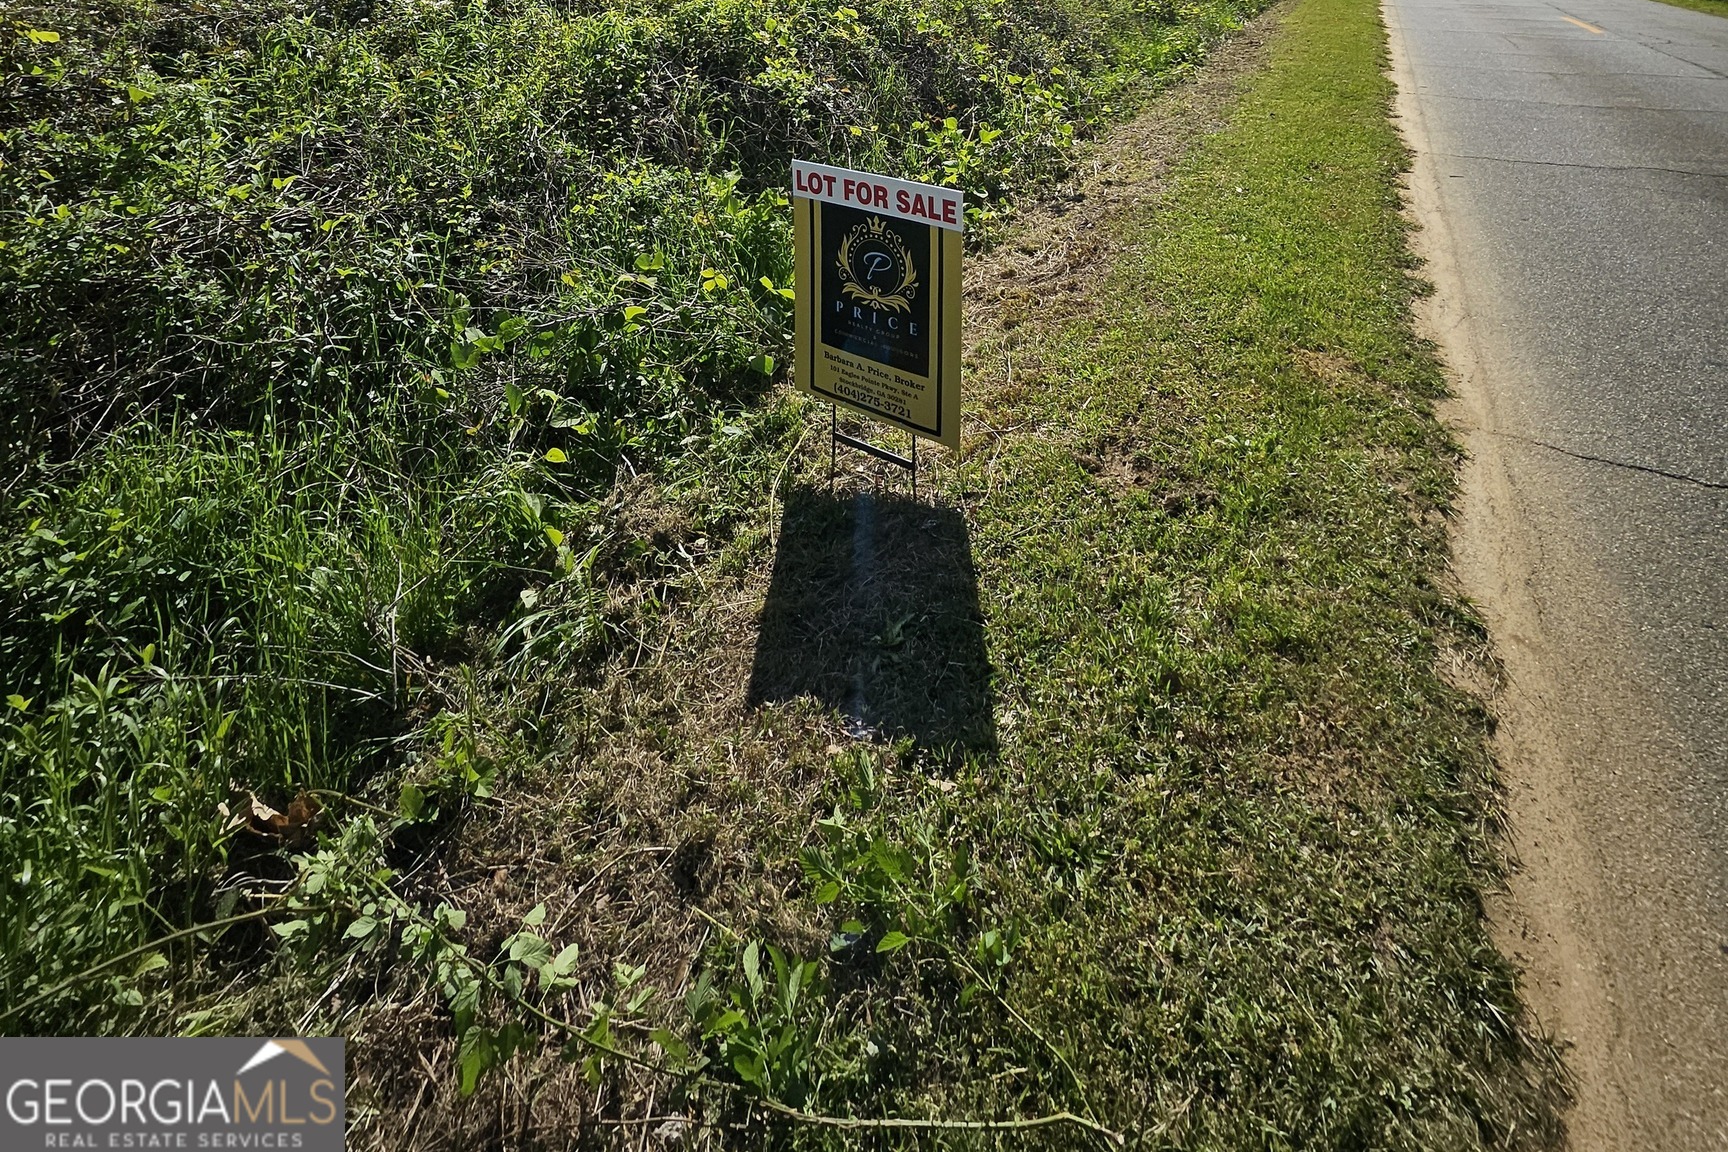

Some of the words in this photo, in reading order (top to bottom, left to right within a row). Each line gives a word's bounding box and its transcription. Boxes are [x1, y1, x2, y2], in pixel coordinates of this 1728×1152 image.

[796, 169, 837, 198] LOT
[843, 178, 889, 210] FOR
[896, 189, 957, 225] SALE
[836, 300, 918, 336] PRICE
[824, 350, 854, 368] Barbara
[856, 363, 865, 372] A.
[867, 365, 892, 381] Price,
[894, 374, 926, 391] Broker
[841, 368, 860, 380] Eagles
[901, 389, 912, 398] Ste
[833, 382, 912, 419] (404)275-3721
[876, 390, 886, 399] GA
